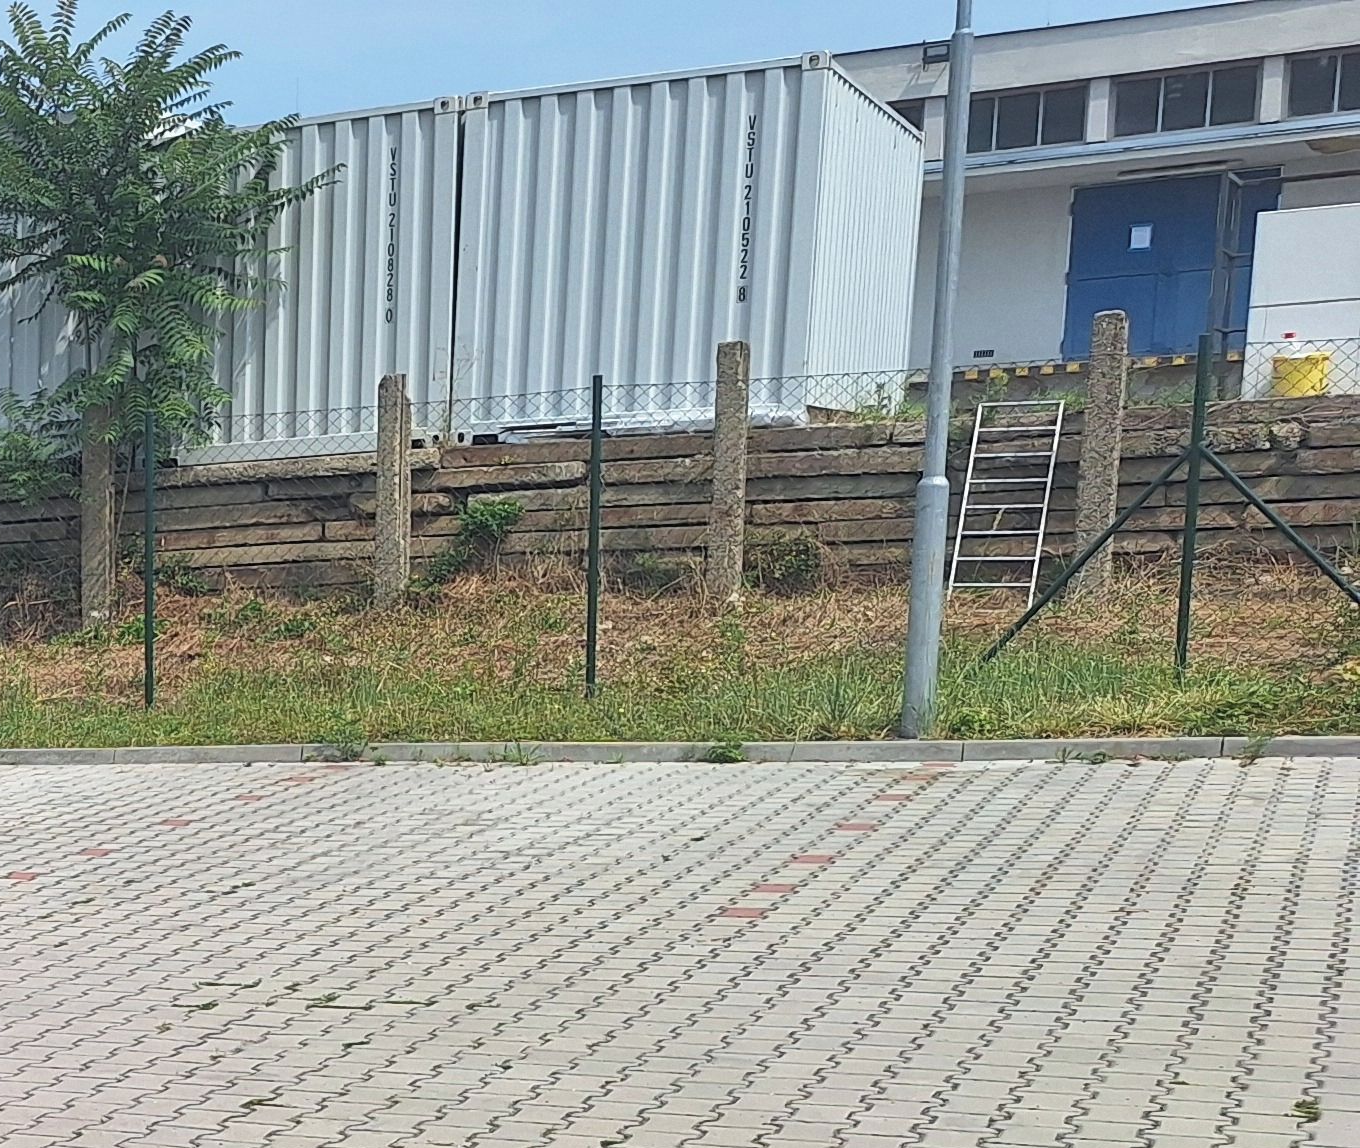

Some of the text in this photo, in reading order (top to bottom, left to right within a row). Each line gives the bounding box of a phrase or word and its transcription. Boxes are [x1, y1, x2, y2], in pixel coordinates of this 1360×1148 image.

[389, 147, 397, 207] VSTU
[738, 115, 756, 302] VSTU 210522 8
[386, 213, 396, 302] 210828
